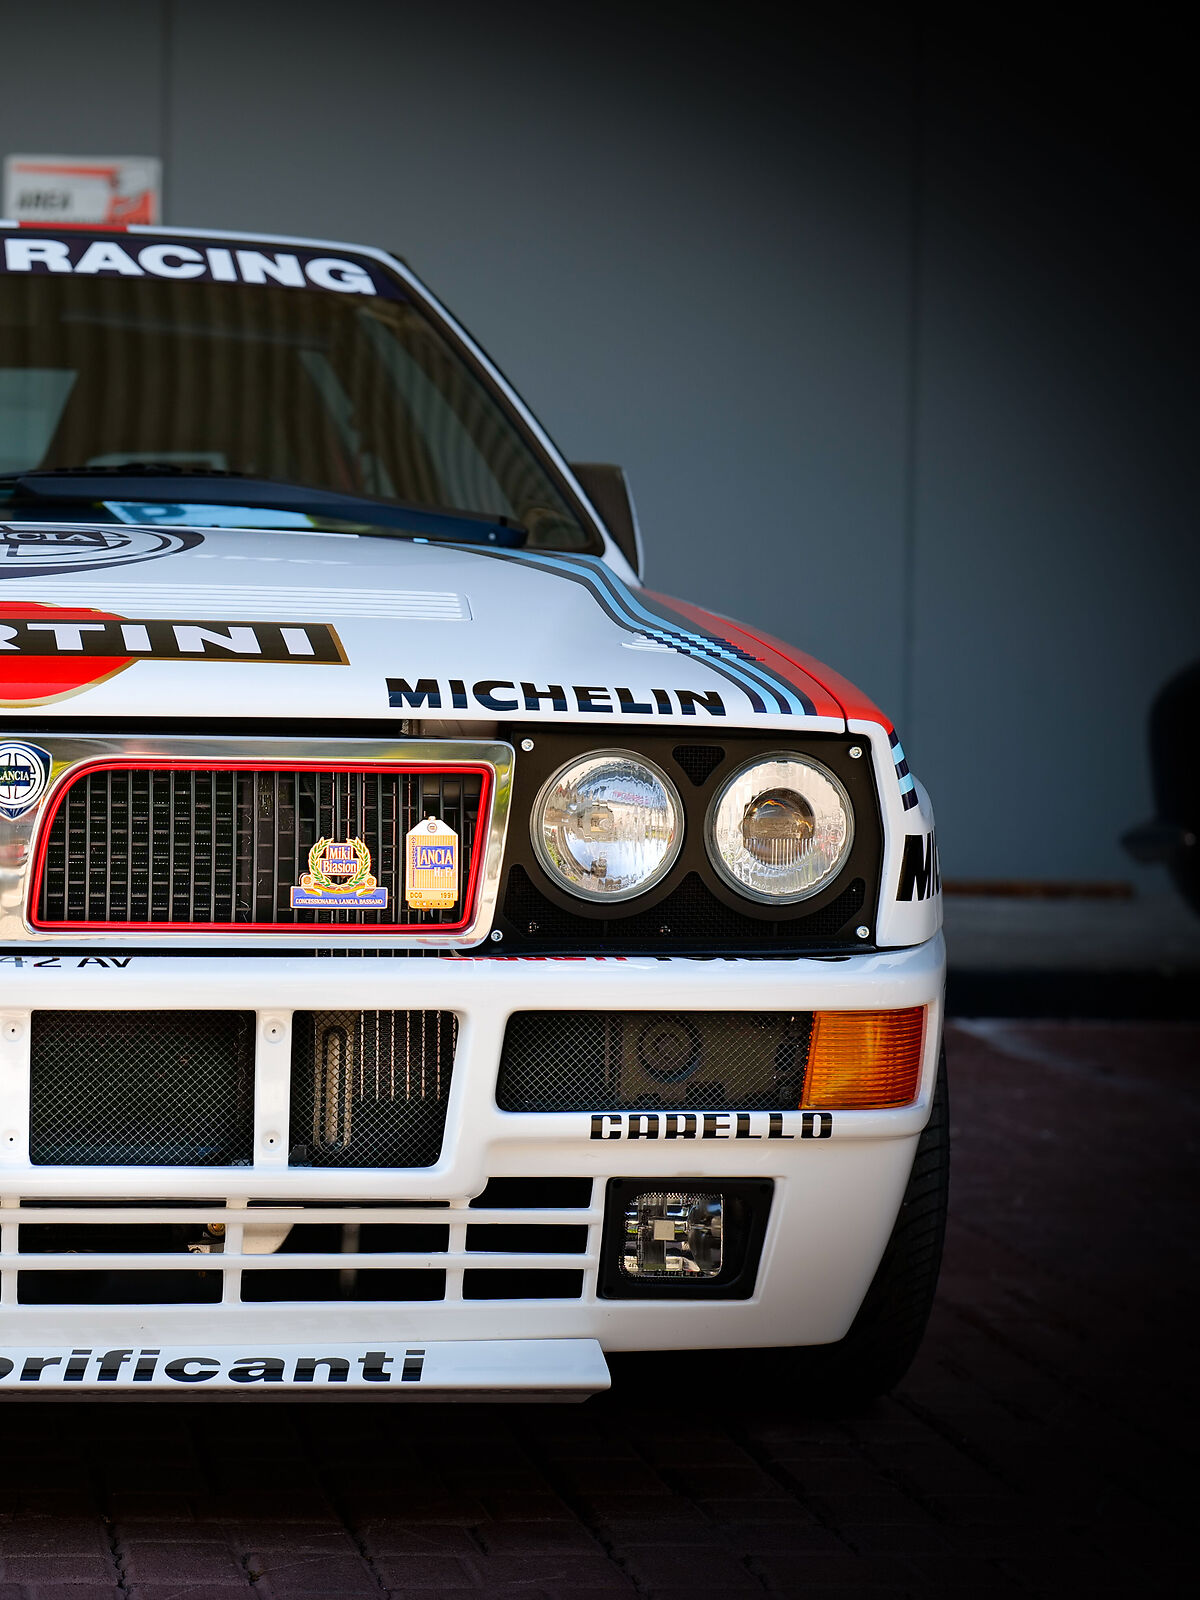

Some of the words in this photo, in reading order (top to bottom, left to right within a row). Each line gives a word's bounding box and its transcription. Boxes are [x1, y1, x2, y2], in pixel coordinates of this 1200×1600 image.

[4, 237, 378, 296] RACING
[384, 677, 727, 717] MICHELIN
[329, 846, 352, 860] Miki
[416, 846, 454, 868] LANCIA
[322, 860, 357, 873] Biasion
[589, 1112, 833, 1139] CARELLO
